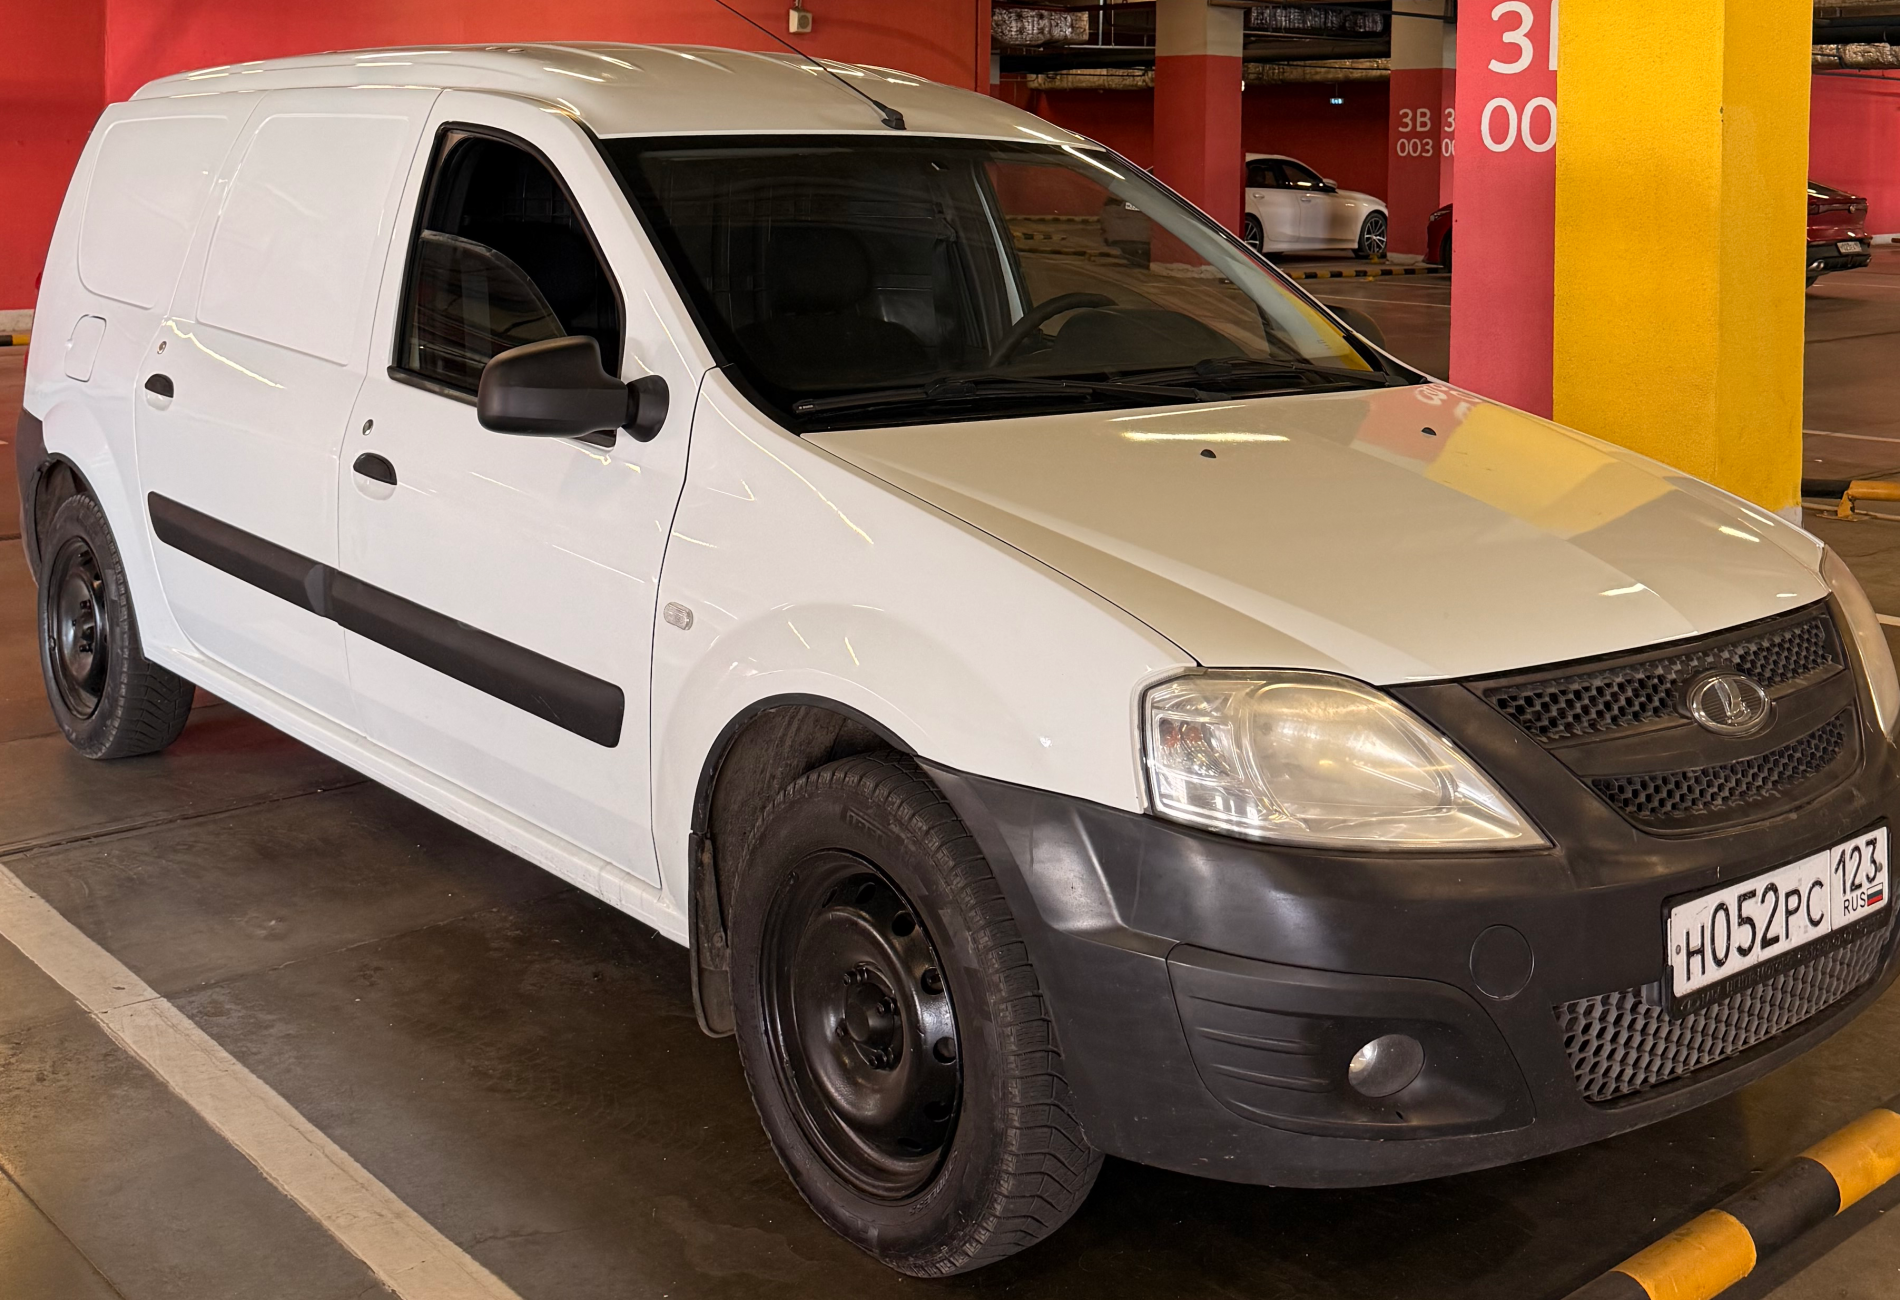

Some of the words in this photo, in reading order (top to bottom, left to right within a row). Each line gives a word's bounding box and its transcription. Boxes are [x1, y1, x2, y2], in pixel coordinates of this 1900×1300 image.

[1488, 0, 1558, 74] 3
[1396, 138, 1433, 156] 003
[1834, 837, 1878, 897] 123
[1843, 891, 1867, 917] RUS
